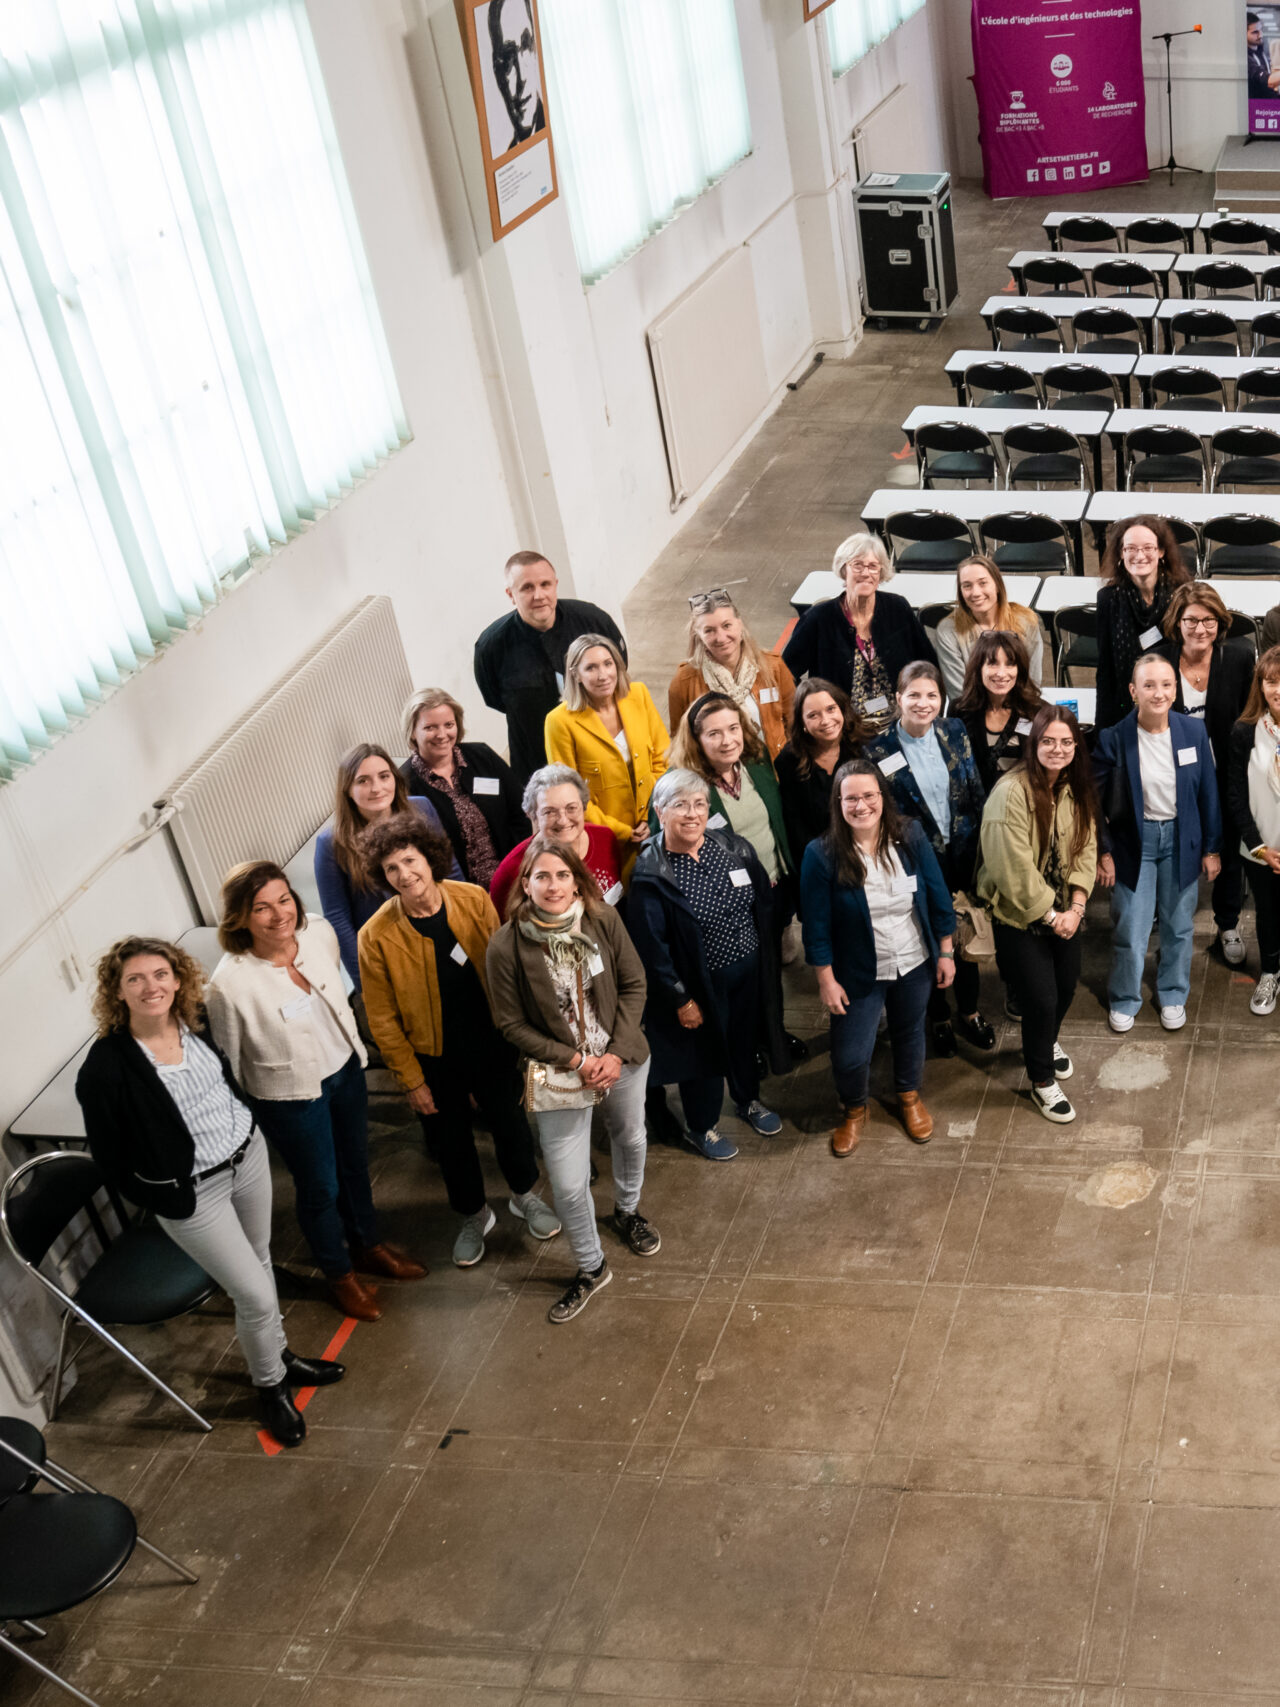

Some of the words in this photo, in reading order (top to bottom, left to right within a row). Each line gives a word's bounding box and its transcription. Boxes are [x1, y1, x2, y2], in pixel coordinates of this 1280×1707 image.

[981, 16, 1008, 25] L'école
[1010, 13, 1059, 26] d'ingénieurs
[1060, 13, 1069, 21] et
[1070, 11, 1083, 20] des
[1084, 7, 1133, 19] technologies
[1095, 101, 1138, 112] LABORATOIRES
[1037, 151, 1099, 164] ARTSETMETIERS.FR
